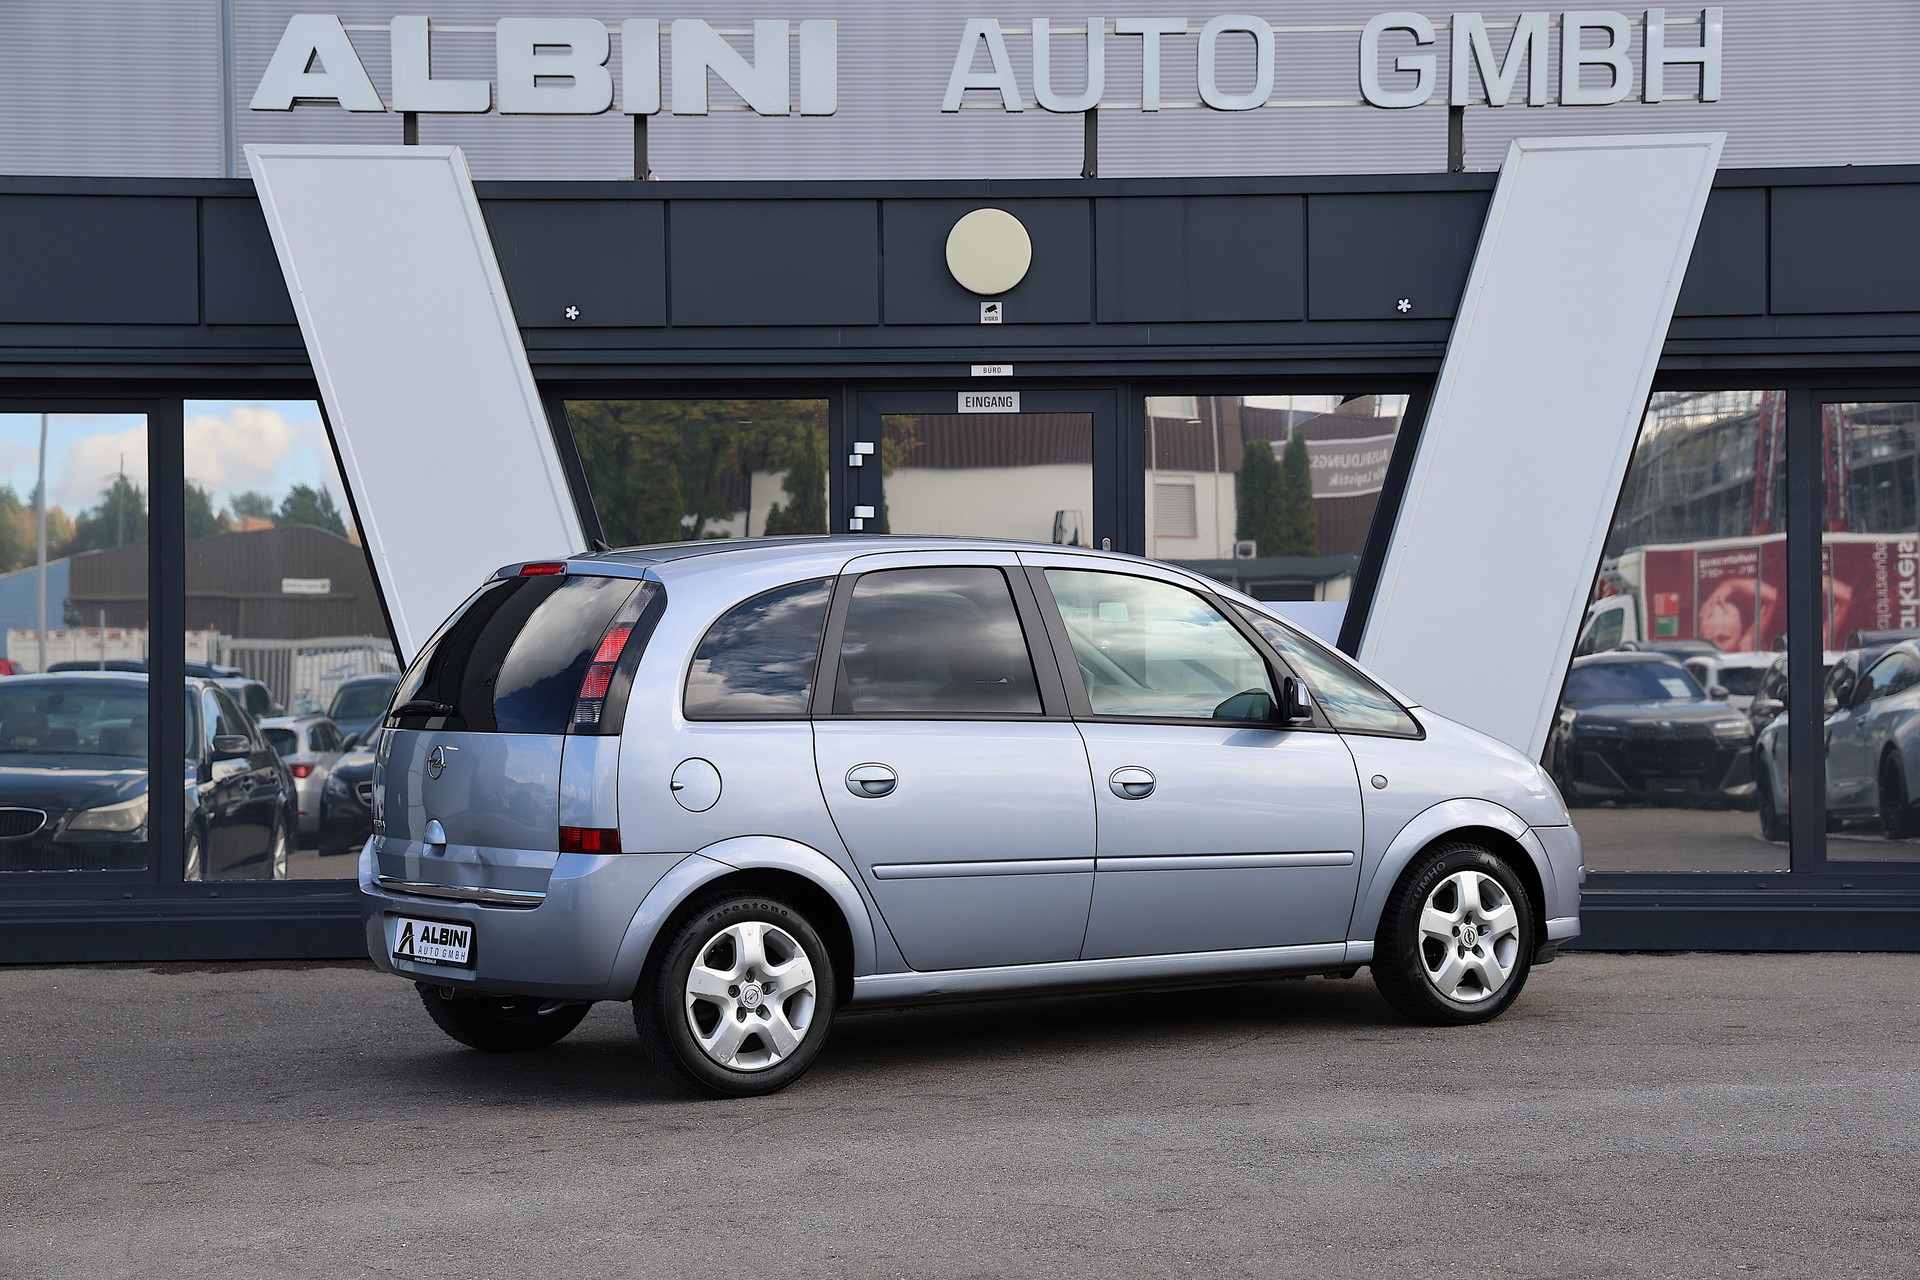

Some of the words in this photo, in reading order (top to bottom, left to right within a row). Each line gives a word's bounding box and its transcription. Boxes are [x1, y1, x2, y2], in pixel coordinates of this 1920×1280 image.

[249, 14, 838, 116] ALBINI
[941, 15, 1276, 114] AUTO
[1358, 6, 1724, 111] GMBH
[983, 365, 1002, 374] BÜRO
[965, 396, 1013, 408] EINGANG
[1410, 861, 1447, 909] KUMHO
[707, 902, 789, 923] Firestone
[420, 926, 468, 948] ALBINI
[418, 946, 439, 957] AUTO
[442, 949, 466, 960] GMBH
